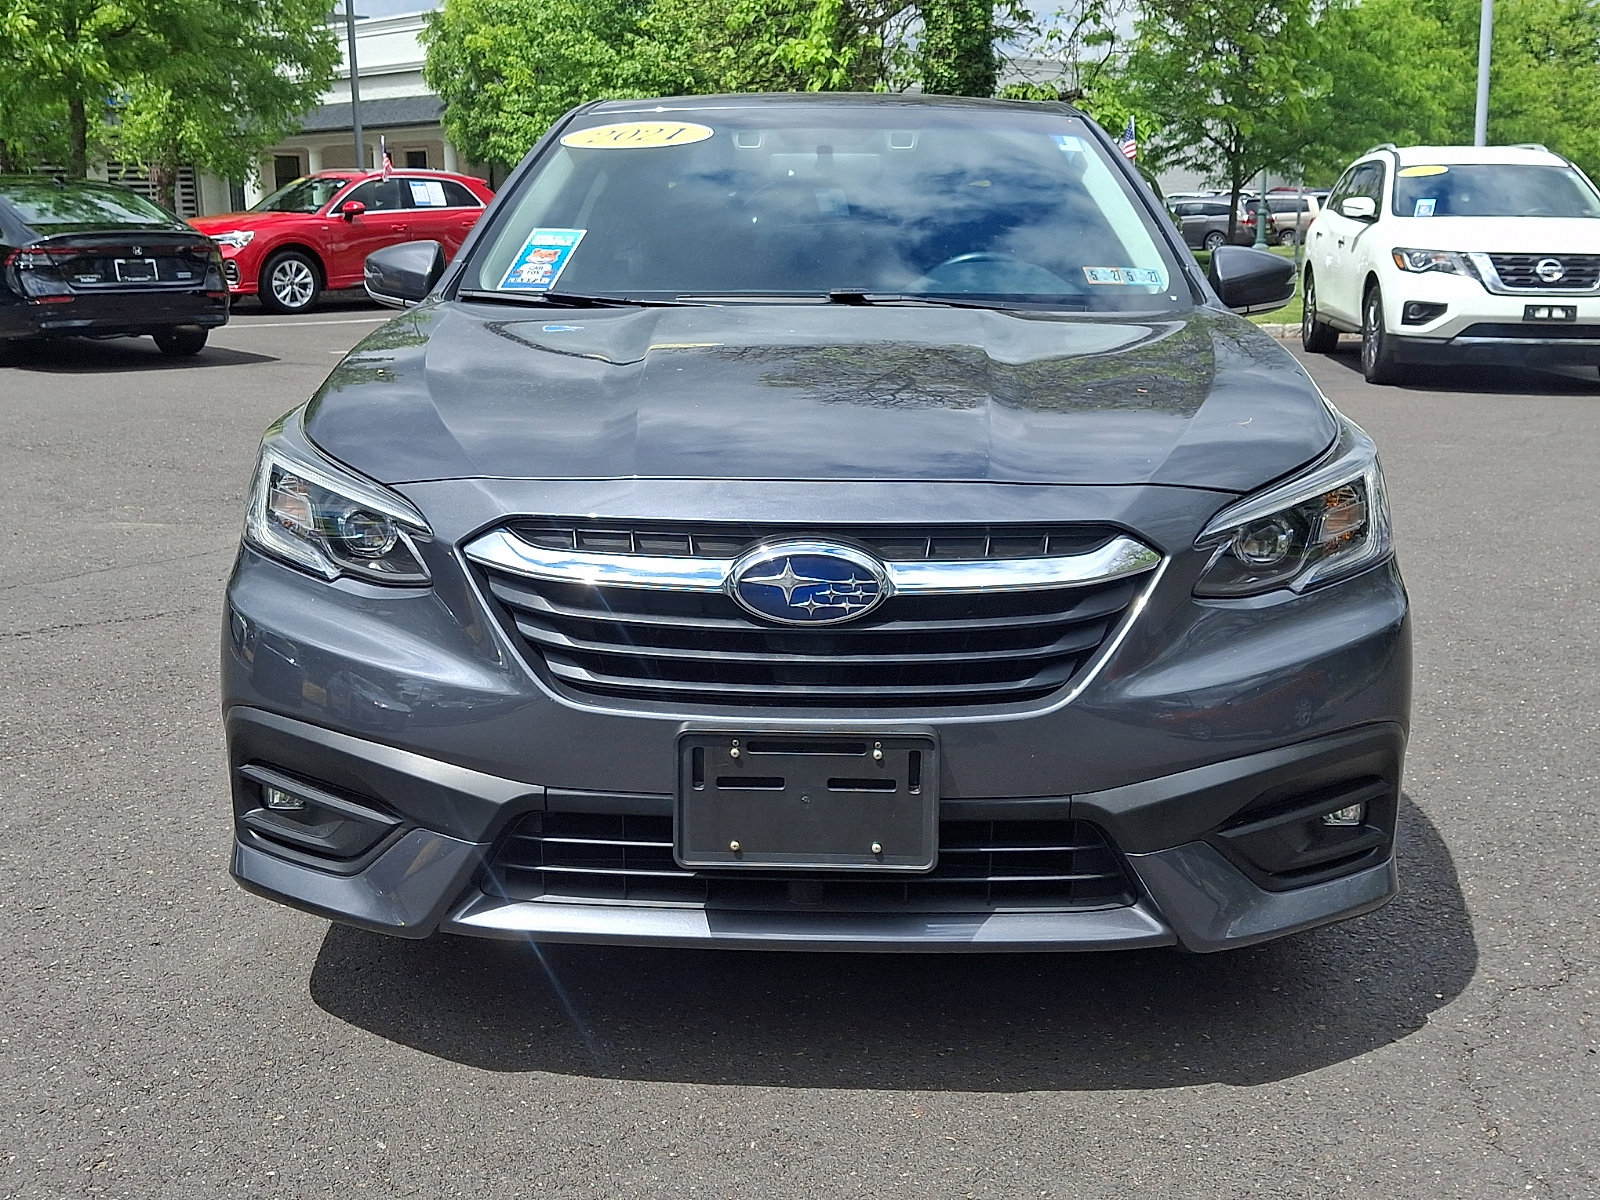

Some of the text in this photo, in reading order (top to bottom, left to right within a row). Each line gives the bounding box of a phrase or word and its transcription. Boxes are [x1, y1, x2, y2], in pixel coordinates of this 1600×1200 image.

[586, 127, 687, 144] 2021
[1090, 270, 1098, 281] 5
[1126, 271, 1134, 282] 5
